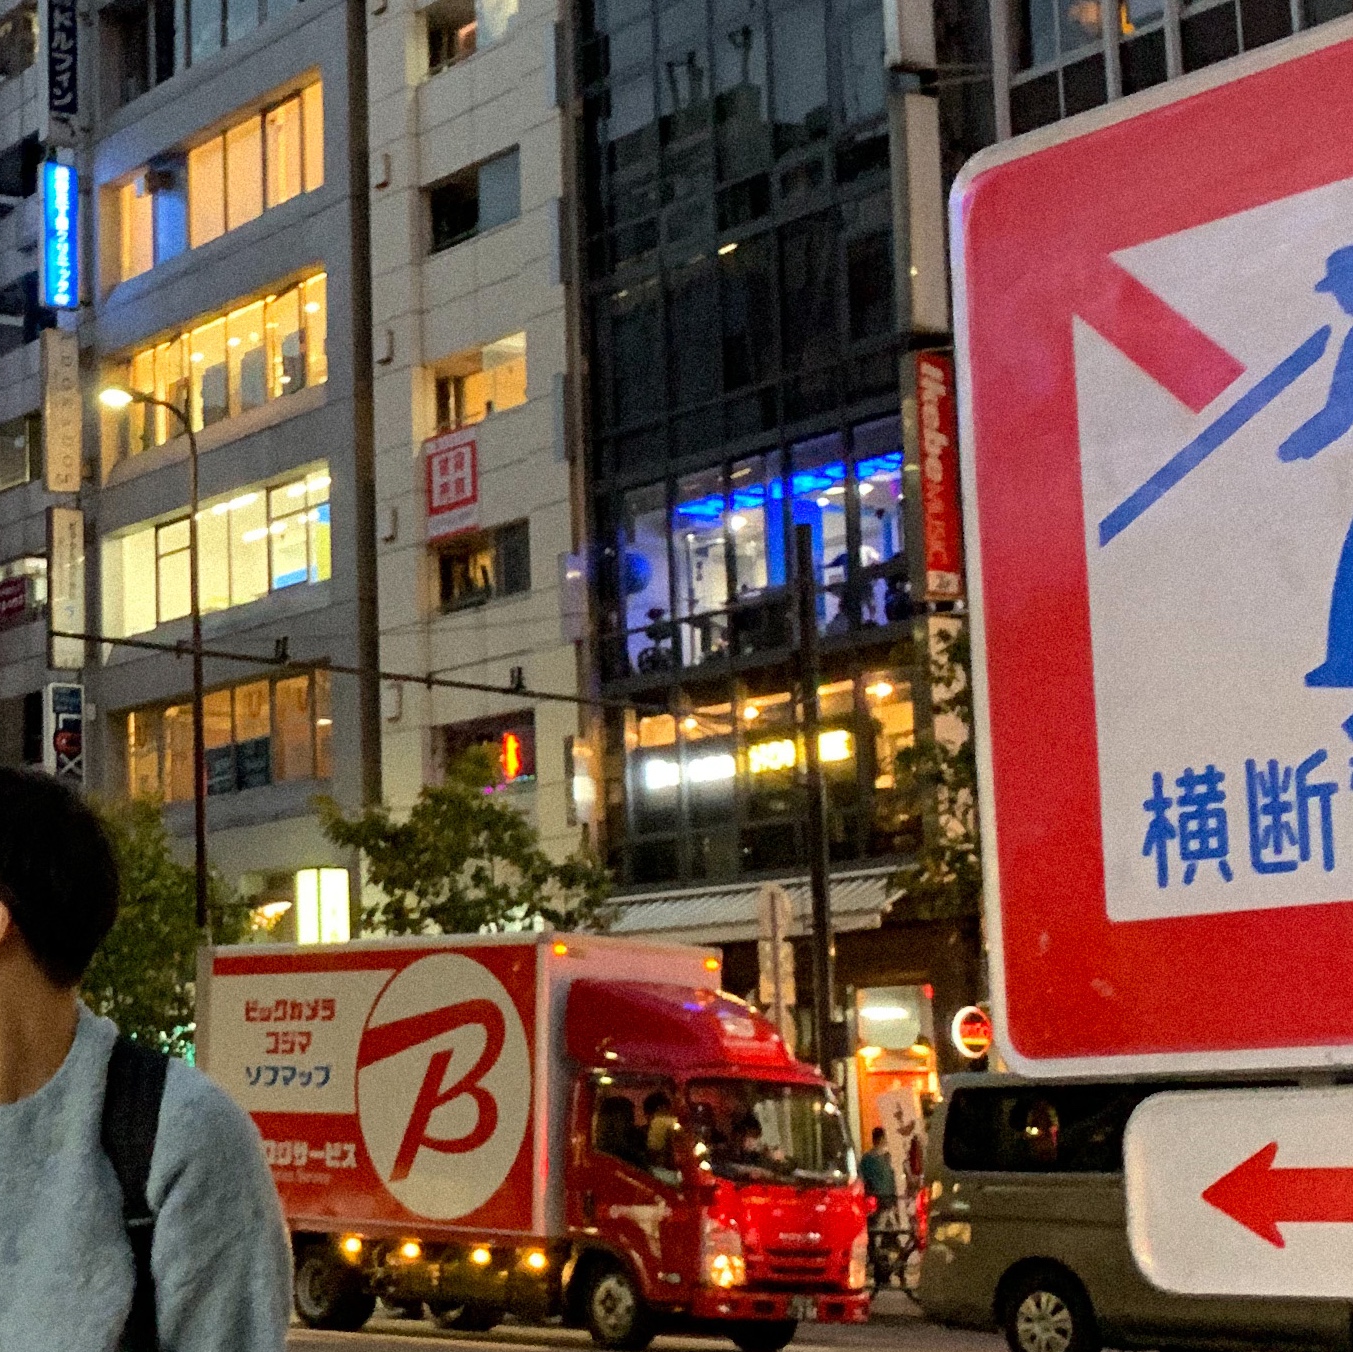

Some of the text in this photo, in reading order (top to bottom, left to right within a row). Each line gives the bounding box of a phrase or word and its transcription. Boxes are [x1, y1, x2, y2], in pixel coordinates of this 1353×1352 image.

[1142, 749, 1353, 888] 横断
[244, 998, 336, 1023] ビックカメラ
[265, 1031, 312, 1055] コジマ
[245, 1064, 332, 1089] ソフマップ
